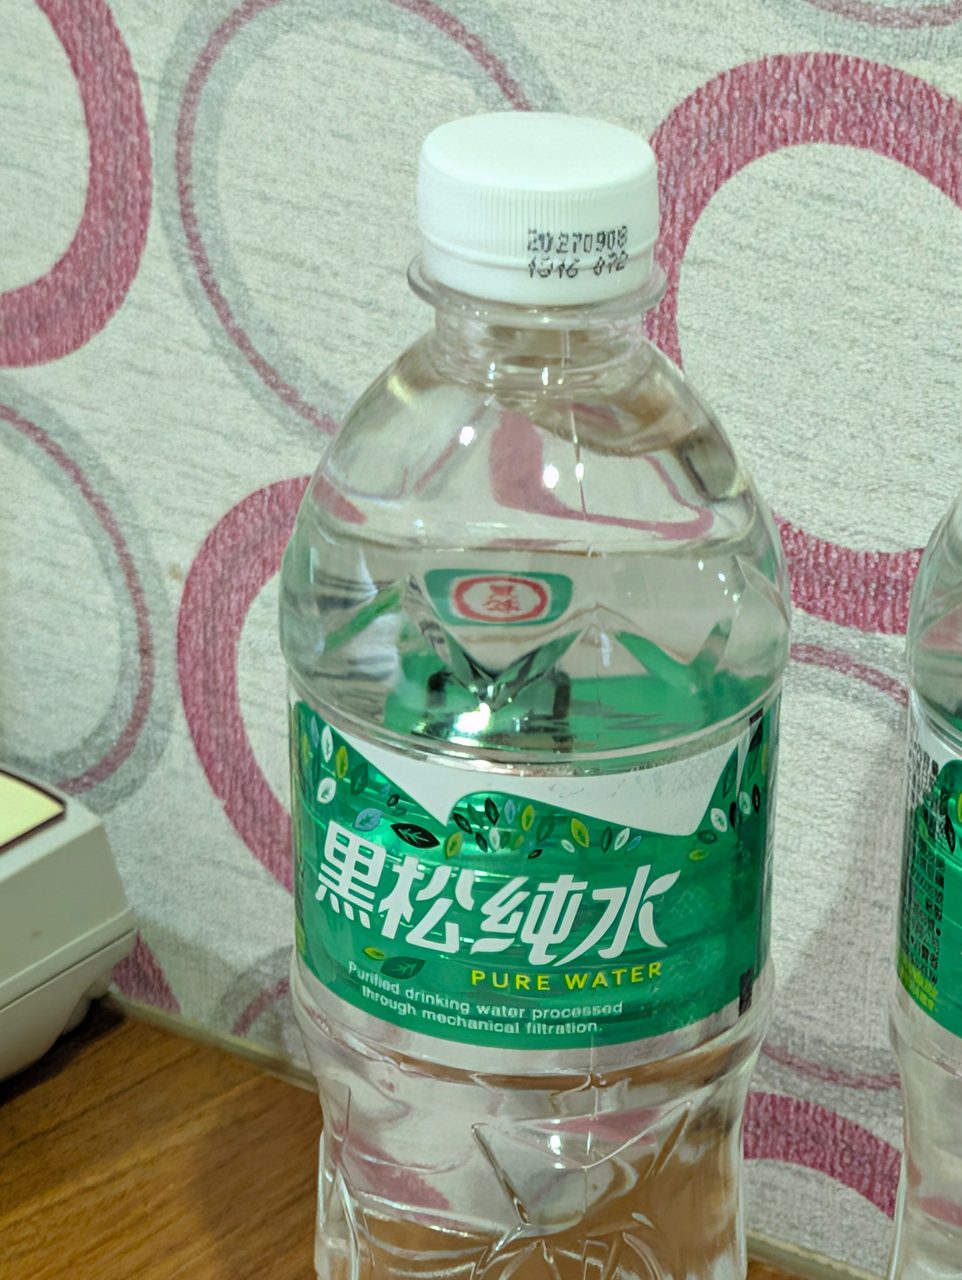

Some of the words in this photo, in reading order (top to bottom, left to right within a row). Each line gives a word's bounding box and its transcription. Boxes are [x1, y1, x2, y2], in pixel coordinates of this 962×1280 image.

[348, 960, 401, 996] Purified
[405, 988, 471, 1016] drinking
[476, 1003, 526, 1019] water
[532, 1001, 624, 1021] processed
[470, 968, 551, 991] PURE
[564, 961, 663, 991] WATER
[362, 984, 418, 1017] through
[422, 1007, 520, 1035] mechanical
